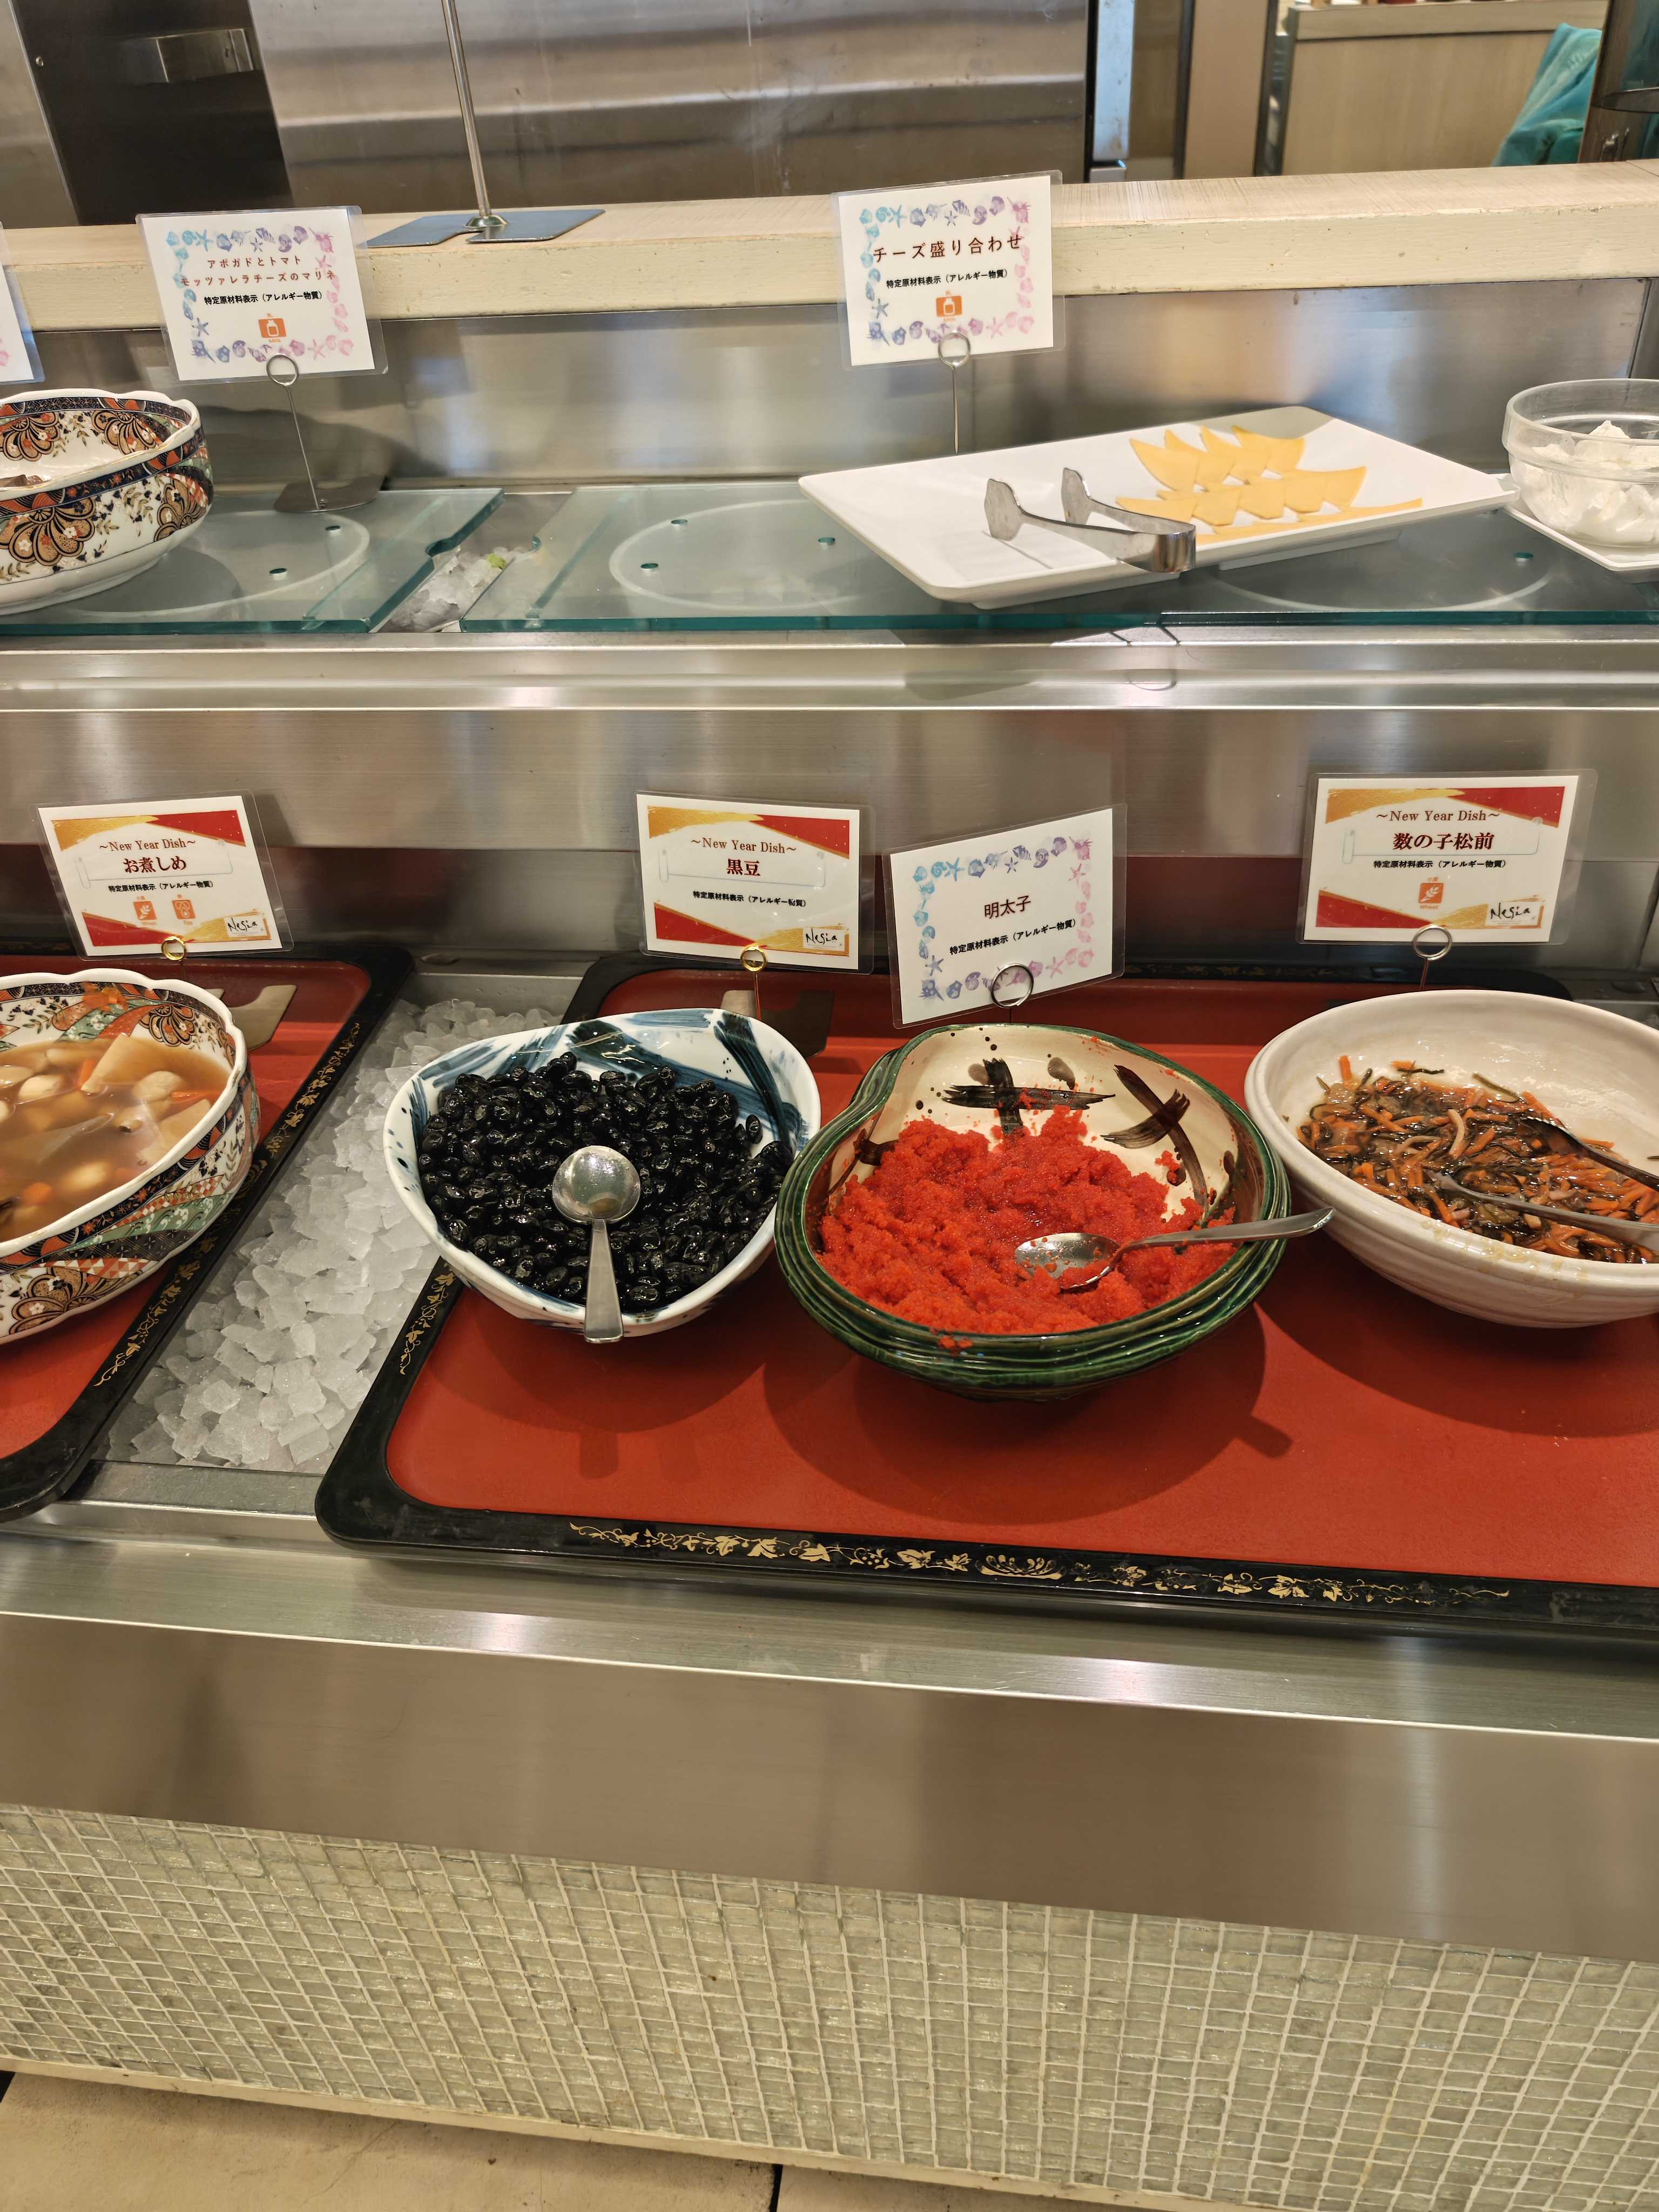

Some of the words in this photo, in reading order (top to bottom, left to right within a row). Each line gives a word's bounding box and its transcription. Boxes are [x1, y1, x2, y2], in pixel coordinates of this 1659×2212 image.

[873, 235, 1022, 262] チーズ盛り合わせ
[181, 270, 335, 286] モッツァレラチーズのマリネ
[1424, 810, 1453, 821] Year
[137, 840, 159, 850] Year
[732, 840, 757, 852] Year
[1392, 832, 1495, 851] 数の子松前
[123, 855, 187, 873] お煮しめ
[727, 858, 761, 876] 黒豆
[984, 895, 1031, 919] 明太子
